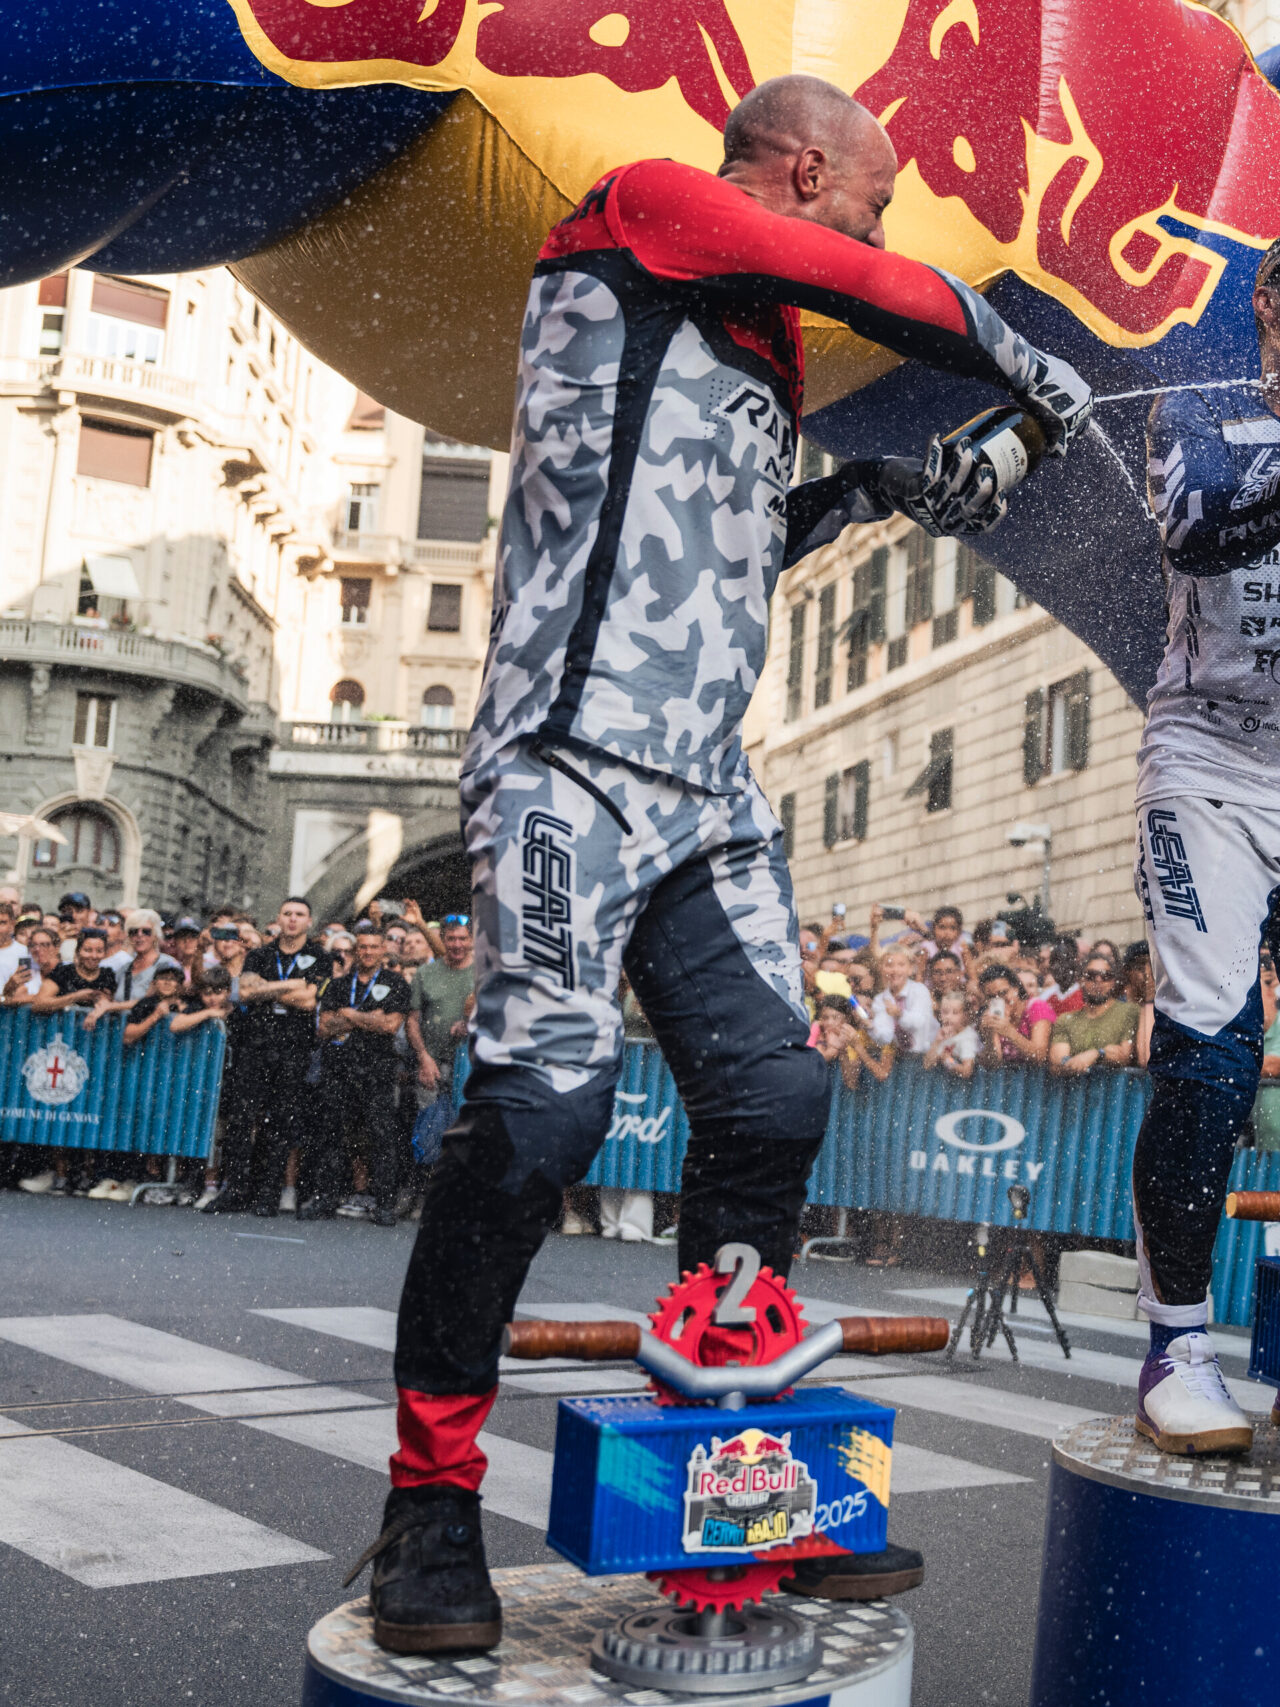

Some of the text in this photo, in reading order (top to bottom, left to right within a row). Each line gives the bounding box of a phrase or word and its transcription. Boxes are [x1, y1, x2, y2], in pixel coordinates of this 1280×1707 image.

[1148, 808, 1208, 934] LEATT
[523, 810, 576, 992] LEATT
[910, 1150, 1044, 1180] OAKLEY
[714, 1242, 761, 1324] 2
[700, 1464, 797, 1496] Red Bull
[747, 1510, 788, 1545] ABAJO
[815, 1490, 869, 1532] 2025
